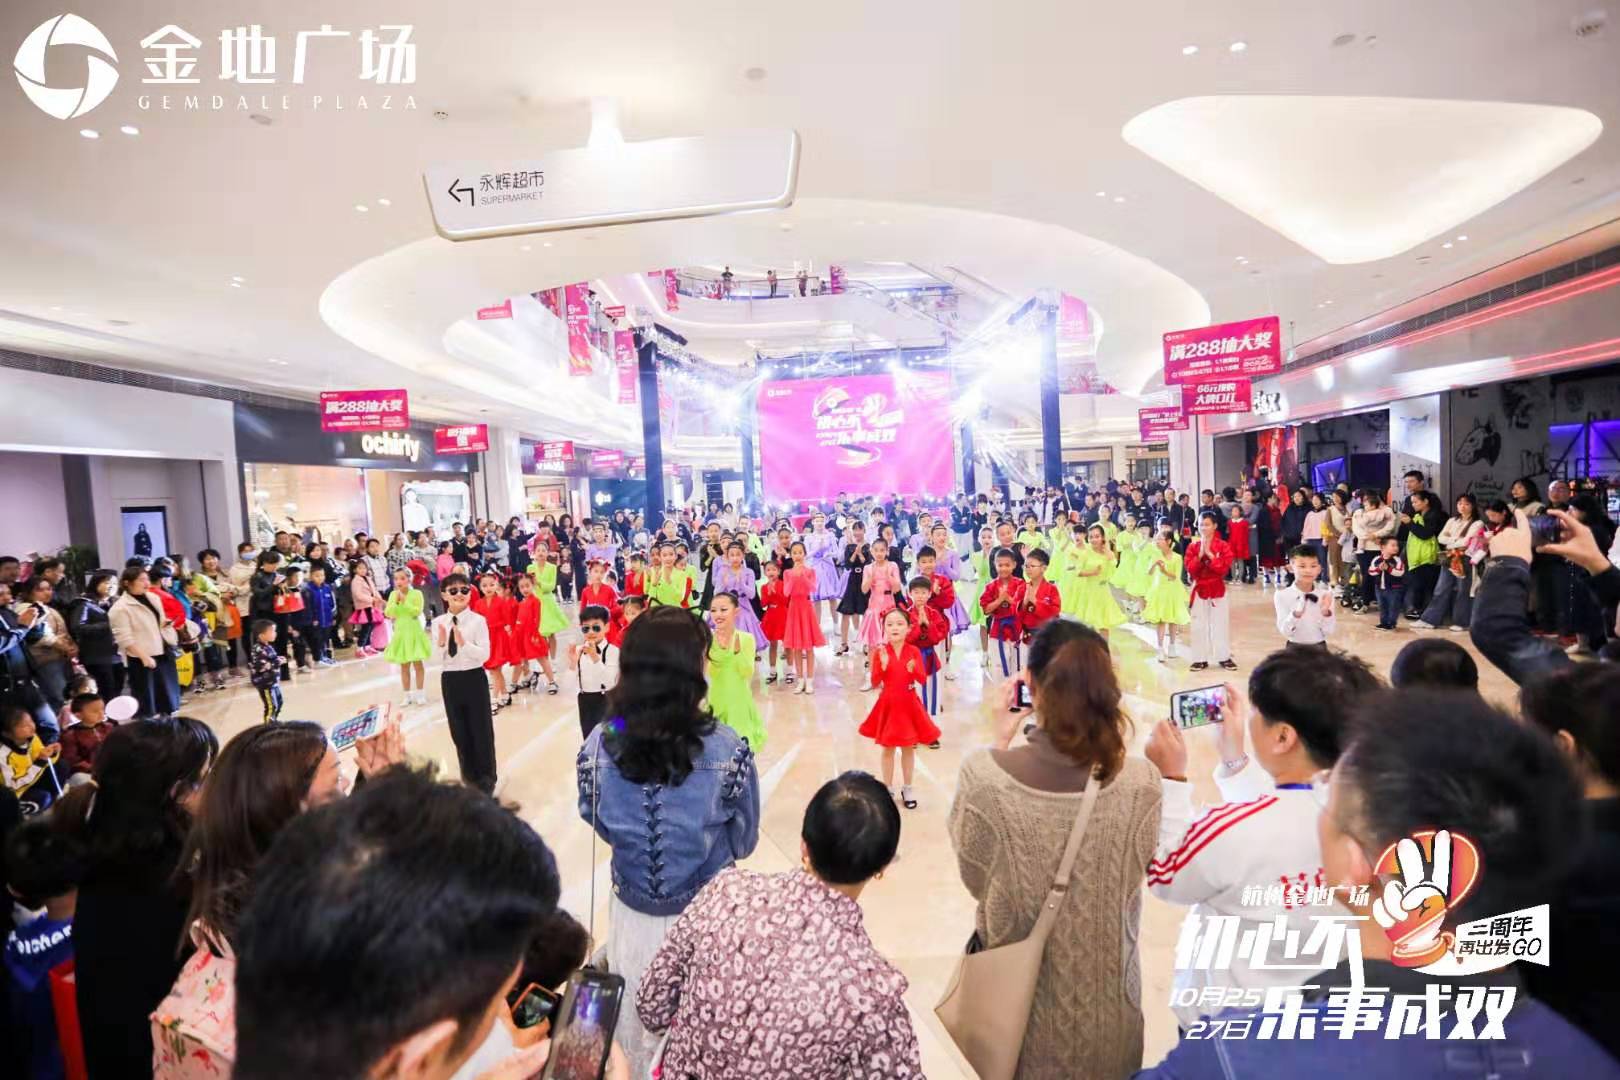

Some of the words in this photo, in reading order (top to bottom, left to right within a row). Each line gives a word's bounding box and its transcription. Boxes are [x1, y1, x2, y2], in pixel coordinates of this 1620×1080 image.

[479, 170, 545, 192] 永辉超市
[480, 191, 544, 206] SUPERMARKET
[1169, 331, 1273, 362] 满288抽大奖
[361, 431, 420, 463] ochirly
